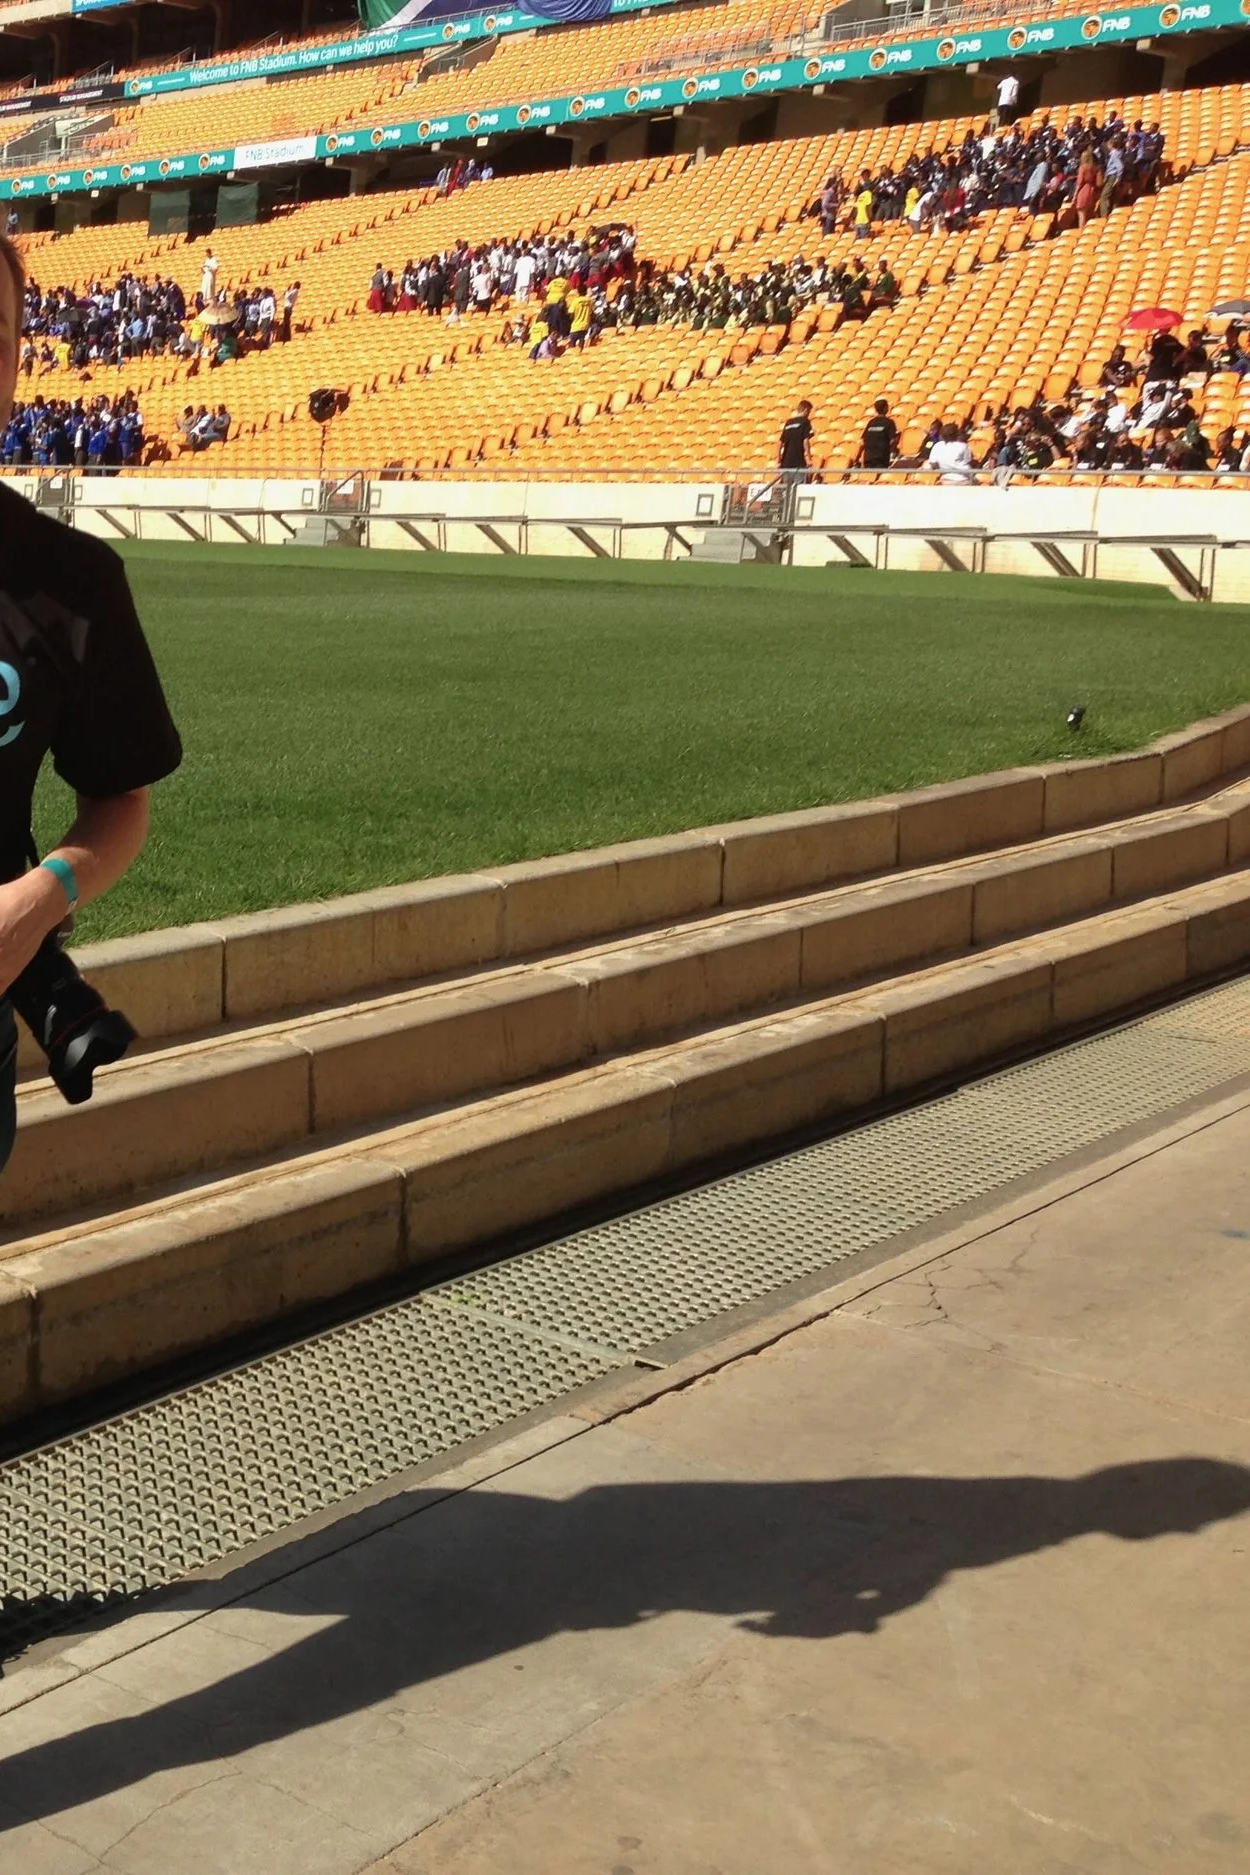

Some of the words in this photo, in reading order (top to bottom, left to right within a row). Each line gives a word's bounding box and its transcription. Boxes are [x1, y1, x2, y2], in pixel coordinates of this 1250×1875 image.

[1181, 5, 1211, 20] FNB
[454, 23, 471, 35] FNB
[1102, 17, 1131, 32] FNB
[1027, 28, 1054, 42] FNB
[955, 39, 982, 53] FNB
[190, 68, 228, 83] Welcome
[229, 65, 238, 77] to
[240, 59, 257, 74] FNB
[259, 54, 297, 72] Stadium.
[299, 50, 319, 66] How
[321, 48, 338, 61] can
[339, 46, 353, 58] we
[353, 38, 375, 56] help
[375, 34, 399, 54] you?
[887, 49, 912, 64] FNB
[821, 59, 846, 72] FNB
[758, 69, 782, 82] FNB
[698, 79, 720, 91] FNB
[640, 88, 662, 101] FNB
[585, 98, 605, 109] FNB
[531, 106, 550, 119] FNB
[480, 114, 498, 126] FNB
[431, 121, 448, 133] FNB
[338, 136, 355, 146] FNB
[383, 129, 400, 141] FNB
[245, 146, 262, 160] FNB
[264, 142, 304, 159] Stadium
[170, 160, 184, 171] FNB
[210, 155, 225, 167] FNB
[93, 171, 107, 181] FNB
[131, 166, 145, 176] FNB
[21, 181, 34, 190] FNB
[57, 175, 70, 185] FNB
